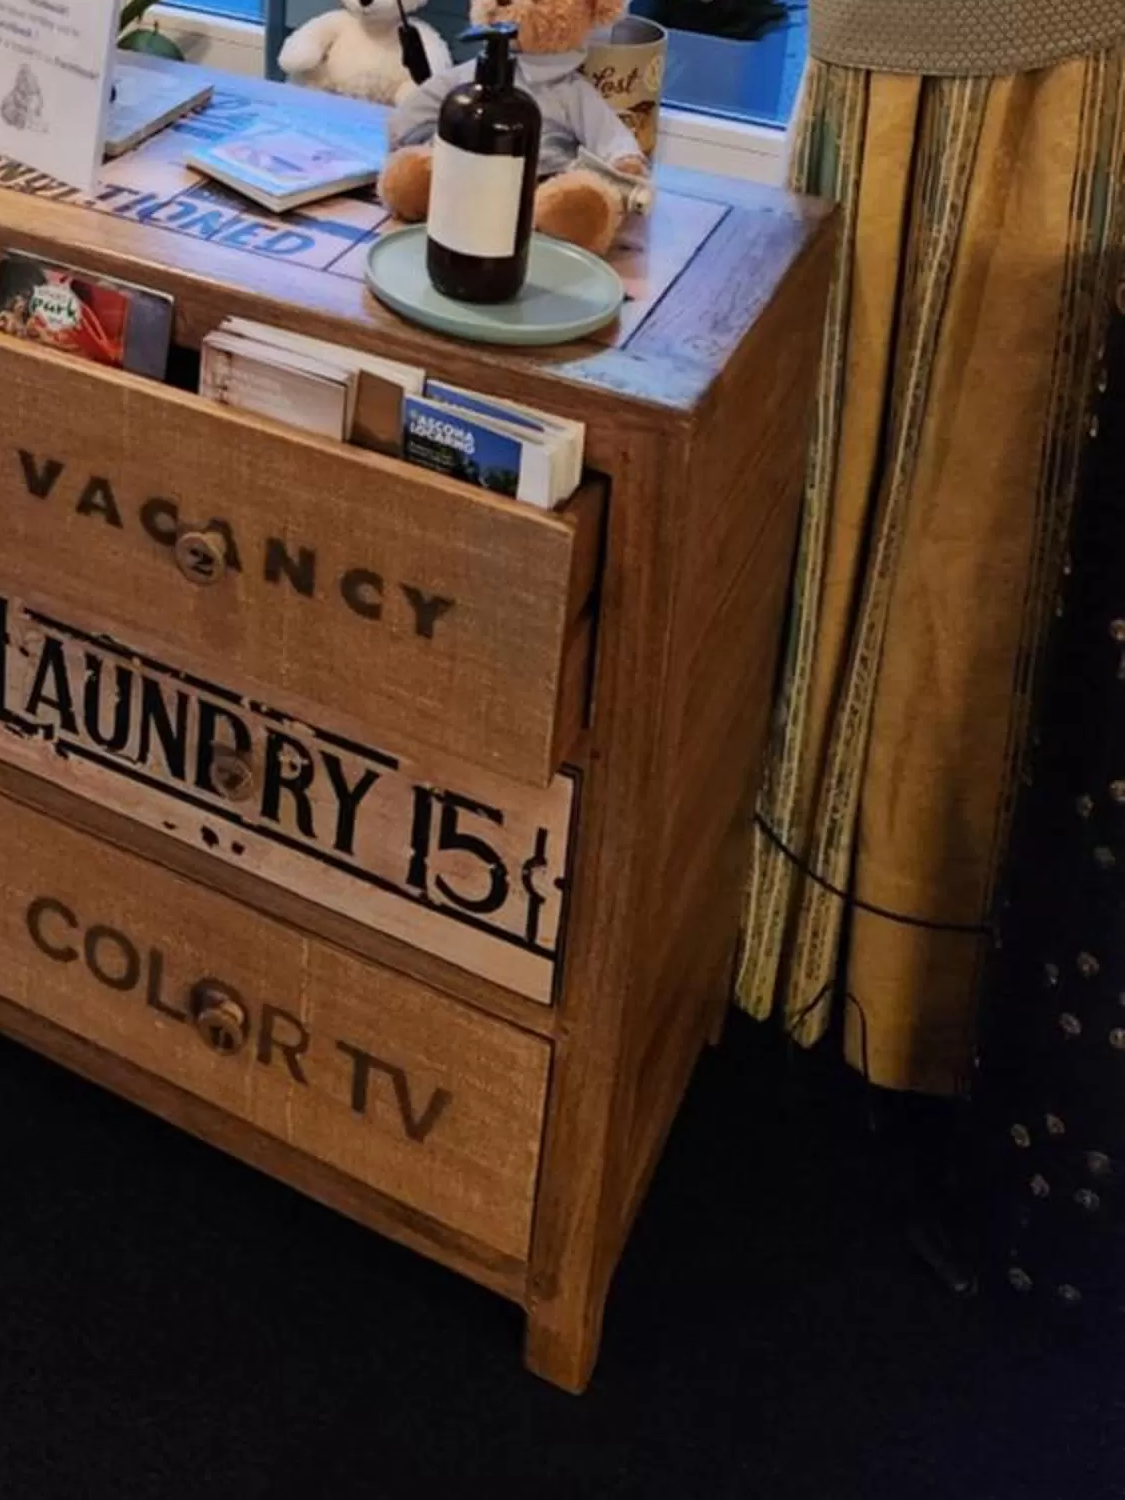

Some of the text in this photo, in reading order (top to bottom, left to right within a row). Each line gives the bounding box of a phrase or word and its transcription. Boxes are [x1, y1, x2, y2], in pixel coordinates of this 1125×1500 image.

[16, 448, 457, 641] VACANCY
[25, 896, 453, 1145] COLOR TV
